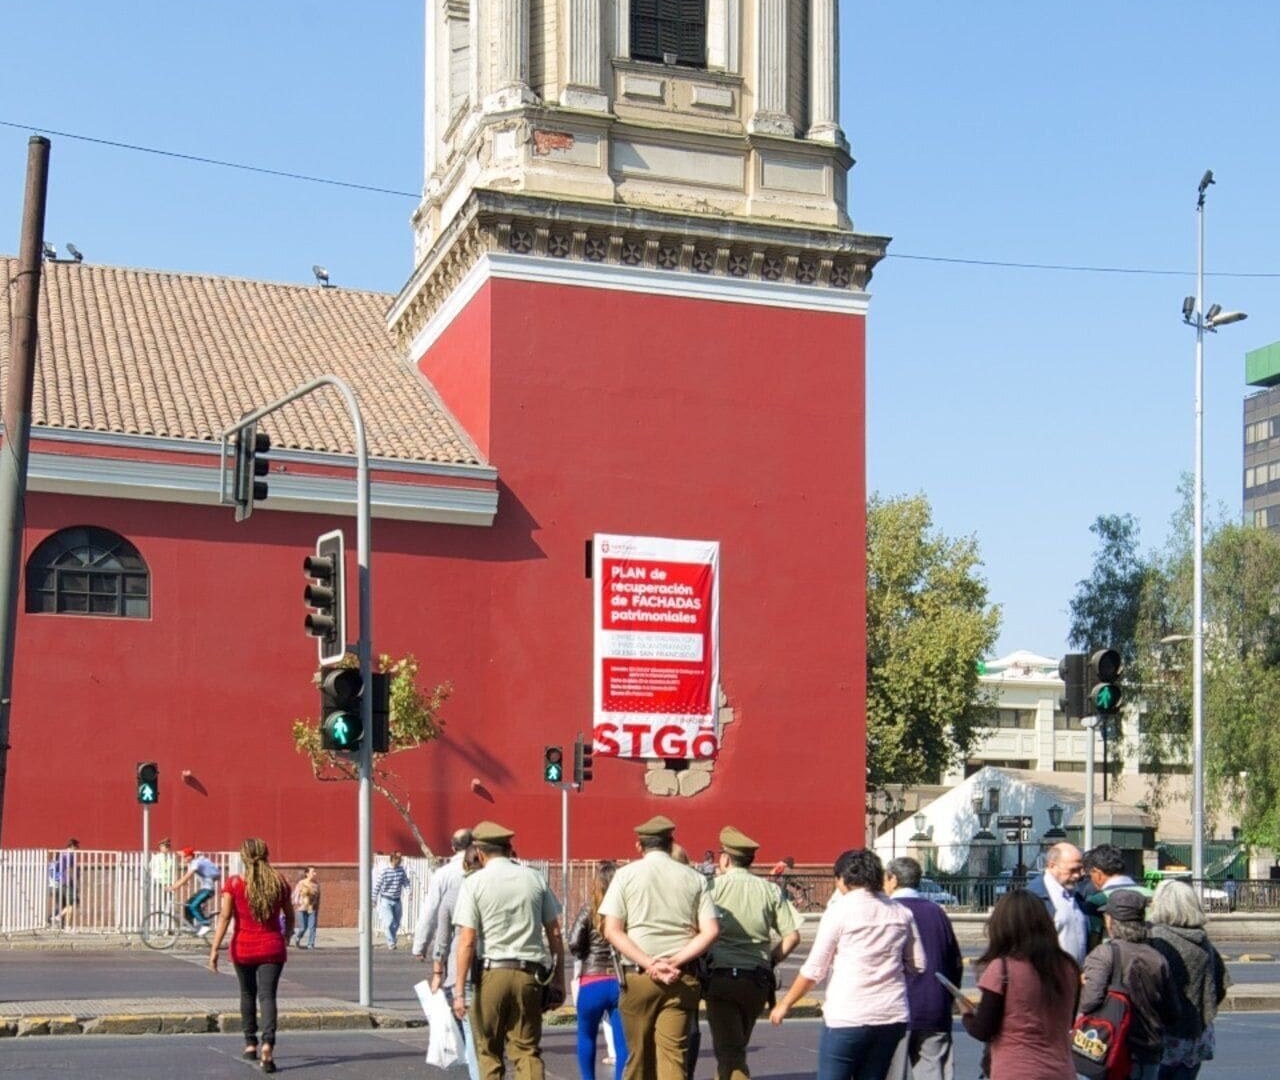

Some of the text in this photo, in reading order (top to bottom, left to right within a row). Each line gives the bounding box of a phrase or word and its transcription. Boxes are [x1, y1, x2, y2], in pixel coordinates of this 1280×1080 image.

[611, 566, 667, 580] PLAN de
[611, 582, 693, 597] recuperación
[611, 595, 701, 610] de FACHADAS
[611, 610, 697, 624] patrimoniales
